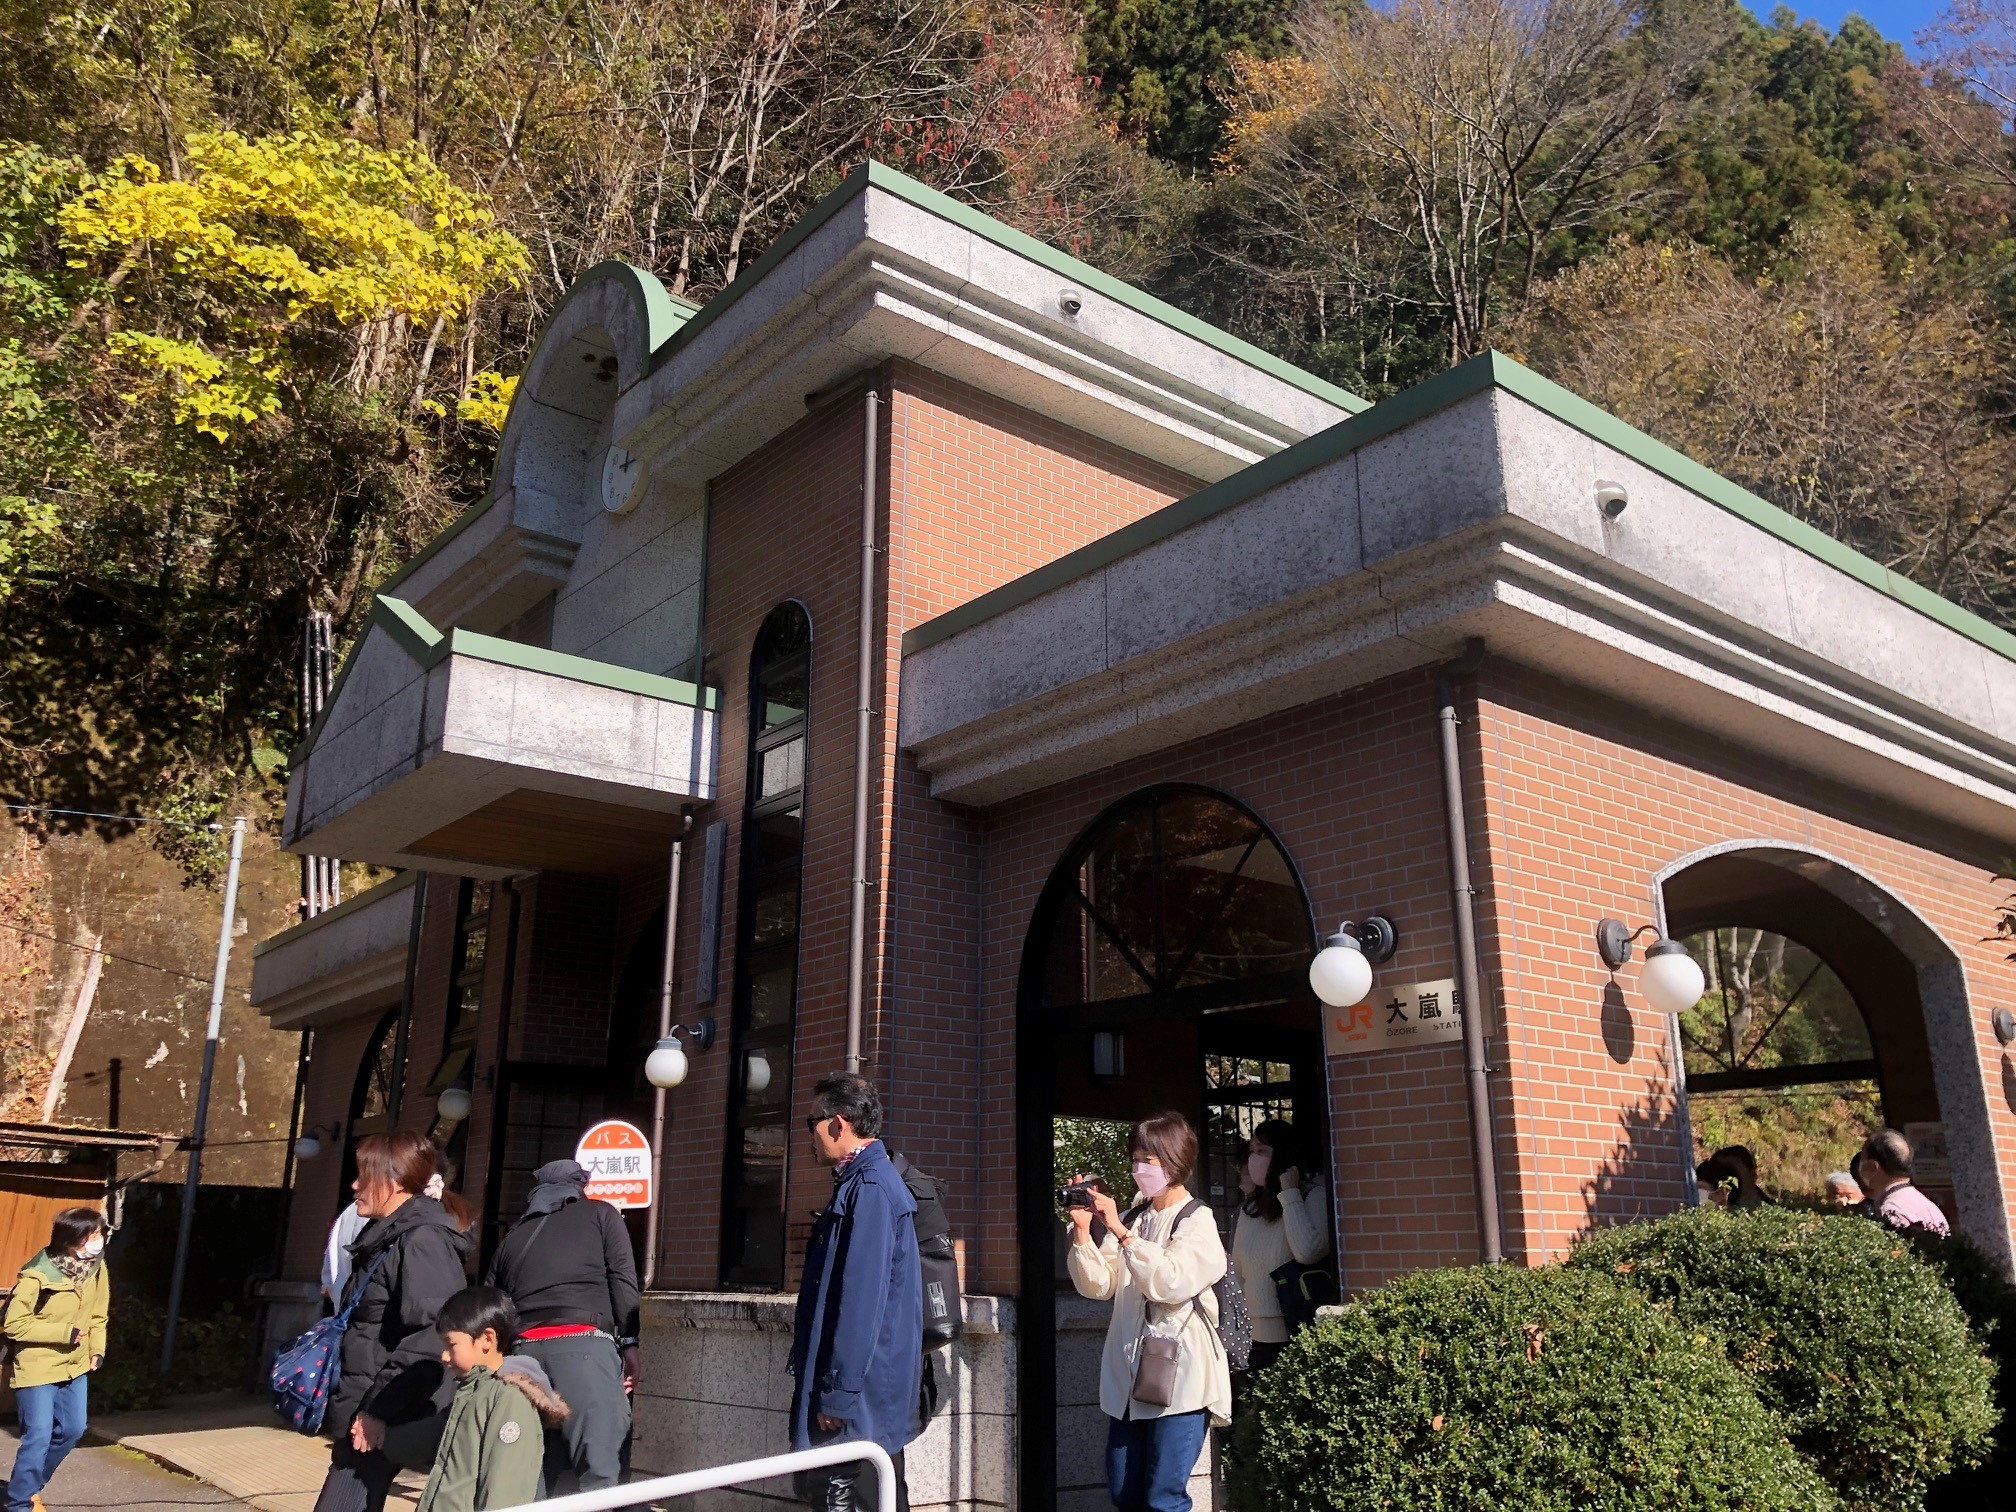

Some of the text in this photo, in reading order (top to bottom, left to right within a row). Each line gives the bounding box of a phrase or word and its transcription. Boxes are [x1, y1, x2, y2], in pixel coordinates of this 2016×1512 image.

[1336, 1004, 1374, 1032] JR
[1433, 1020, 1461, 1031] STATI
[596, 1131, 632, 1145] バス
[587, 1156, 641, 1174] 大嵐駅
